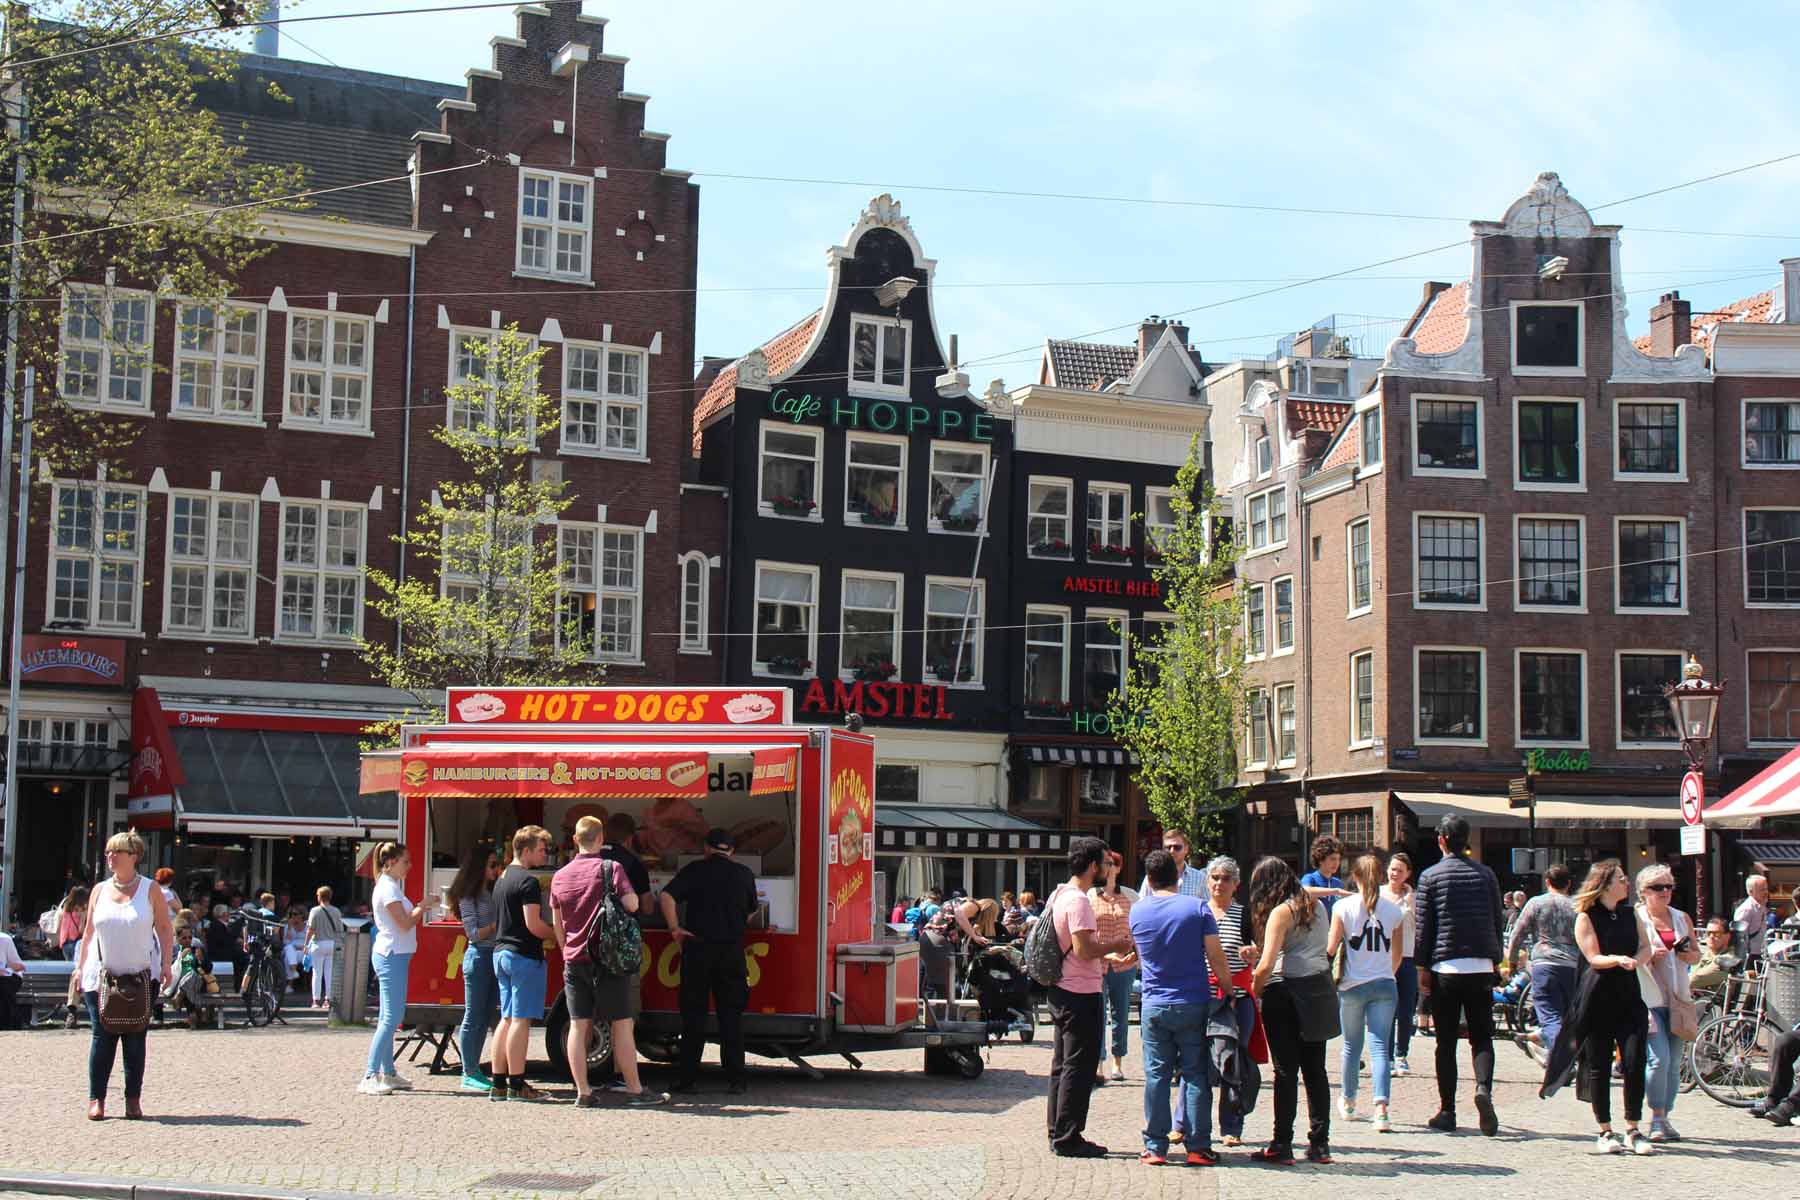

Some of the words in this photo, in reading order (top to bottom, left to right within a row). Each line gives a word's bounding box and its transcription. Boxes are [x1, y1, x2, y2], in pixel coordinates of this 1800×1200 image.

[771, 387, 822, 425] Café
[834, 397, 993, 441] HOPPE
[1063, 575, 1122, 594] AMSTEL
[1125, 579, 1161, 598] BIER
[518, 693, 710, 722] HOT-DOGS
[800, 676, 955, 720] AMSTEL
[433, 767, 550, 781] HAMBURGERS
[550, 761, 575, 785] &
[575, 767, 662, 781] HOT-DOGS
[831, 768, 871, 819] HOT-DOGS
